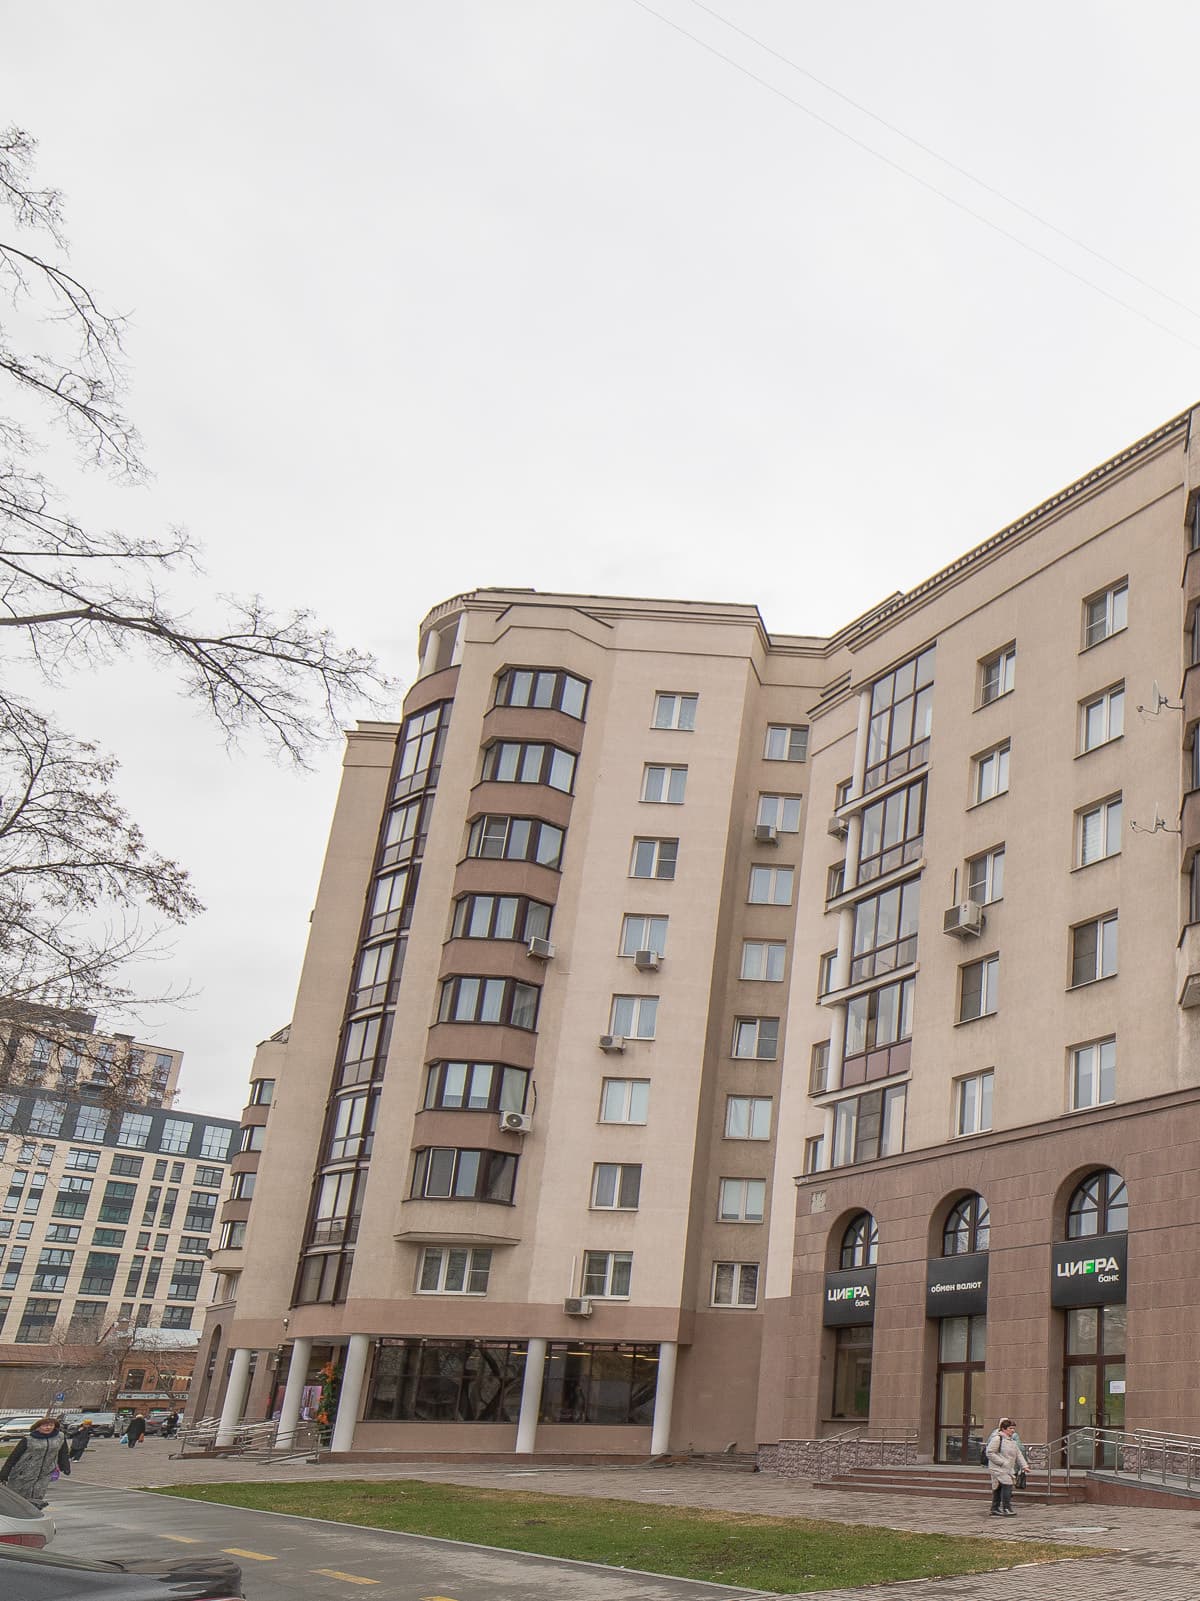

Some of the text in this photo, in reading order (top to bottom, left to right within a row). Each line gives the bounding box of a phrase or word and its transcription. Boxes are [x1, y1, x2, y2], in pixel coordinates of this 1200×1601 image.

[1097, 1273, 1120, 1283] банк
[930, 1281, 982, 1293] обмен валют
[854, 1299, 870, 1307] банк
